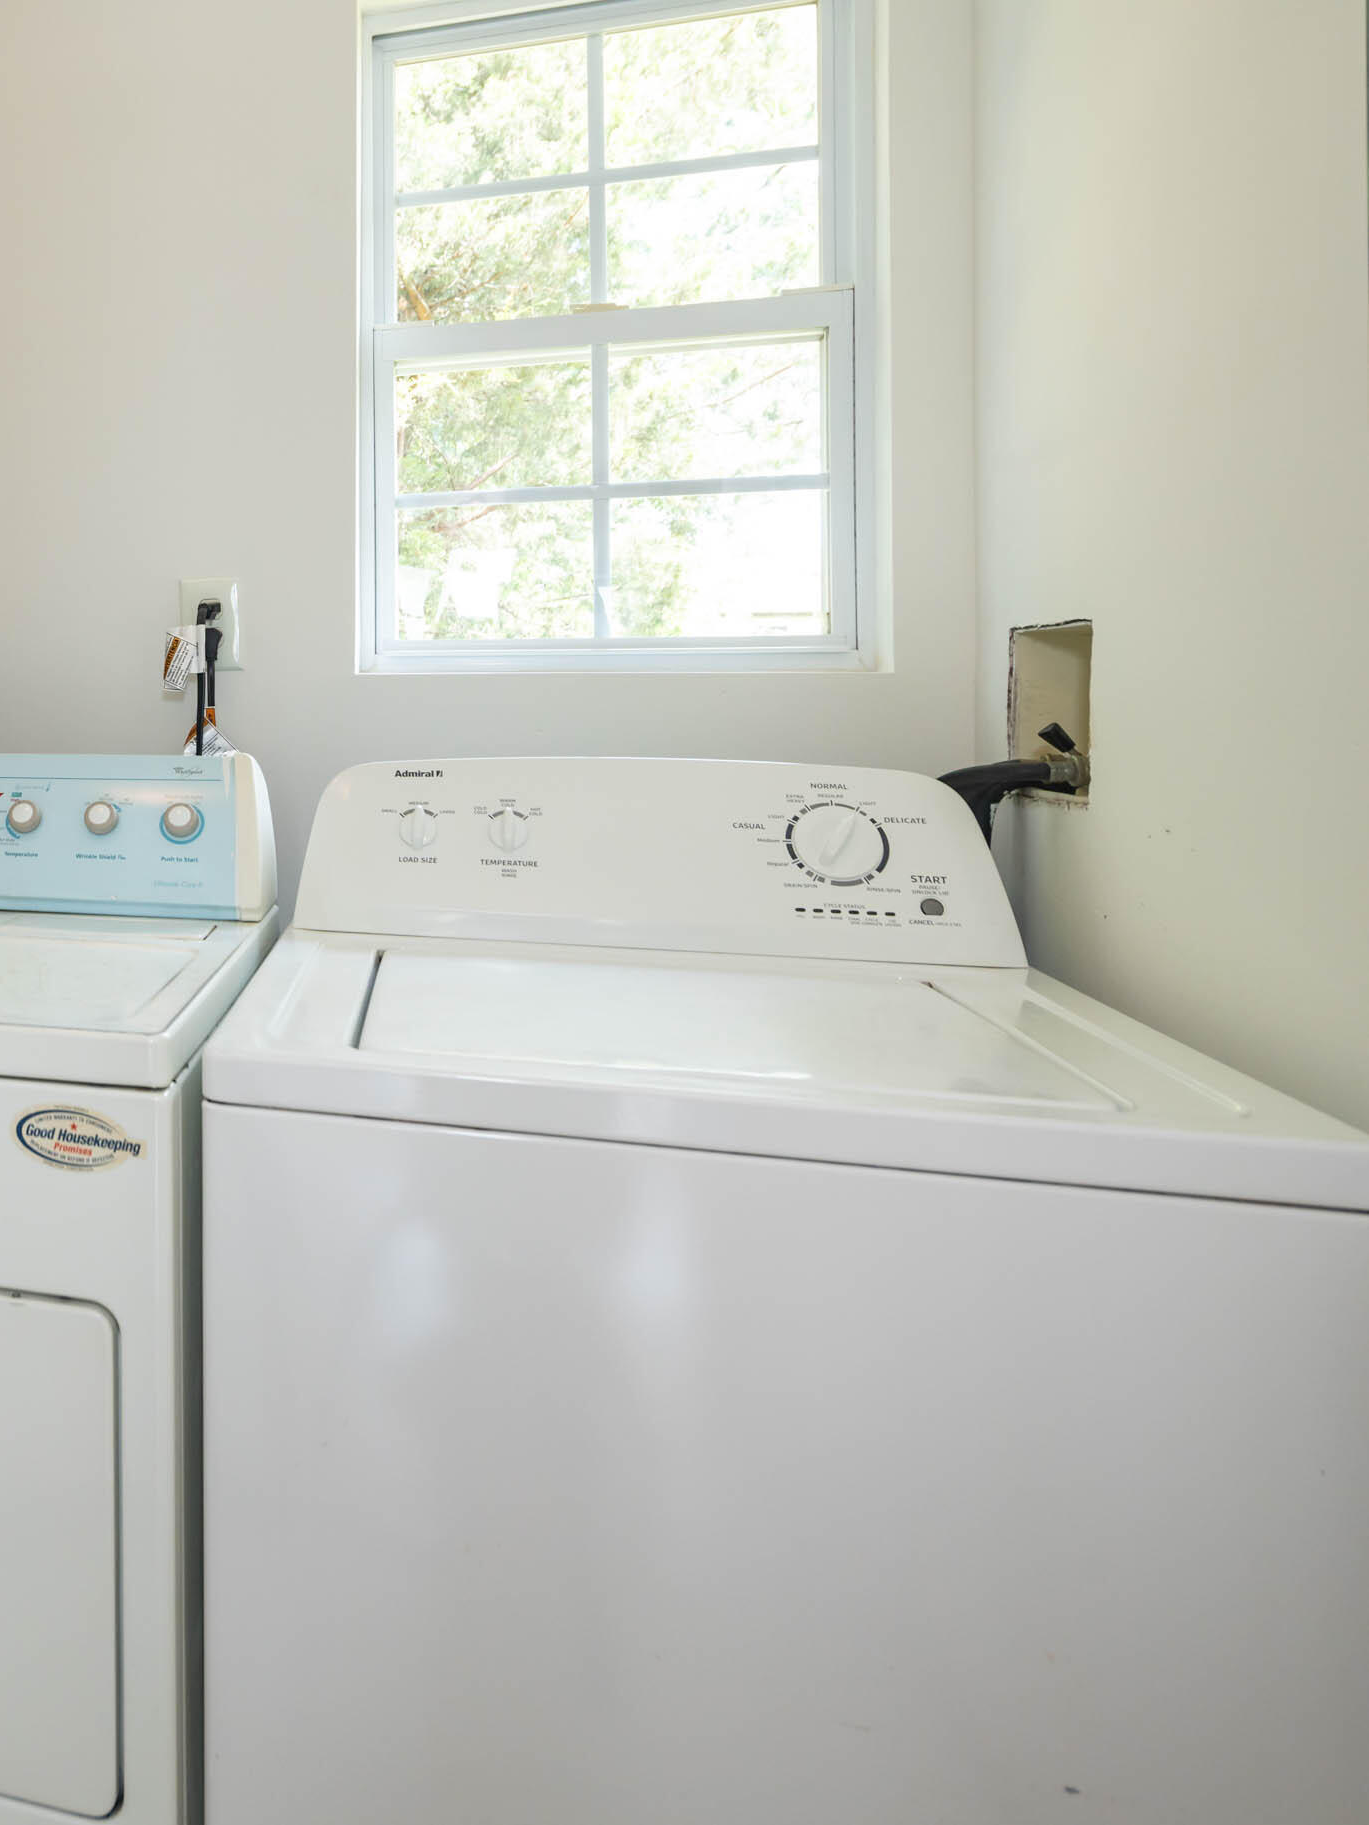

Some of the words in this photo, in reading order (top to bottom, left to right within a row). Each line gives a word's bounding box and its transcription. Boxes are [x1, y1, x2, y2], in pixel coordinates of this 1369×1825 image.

[394, 770, 435, 779] Admiral
[810, 782, 848, 790] NORMAL
[883, 816, 928, 825] DELICATE
[732, 822, 767, 831] CASUAL
[398, 856, 420, 864] LOAD
[480, 858, 539, 868] TEMPERATURE
[910, 874, 948, 885] START
[25, 1123, 56, 1140] Good
[57, 1127, 142, 1157] Housekeeping
[53, 1141, 93, 1157] Promises
